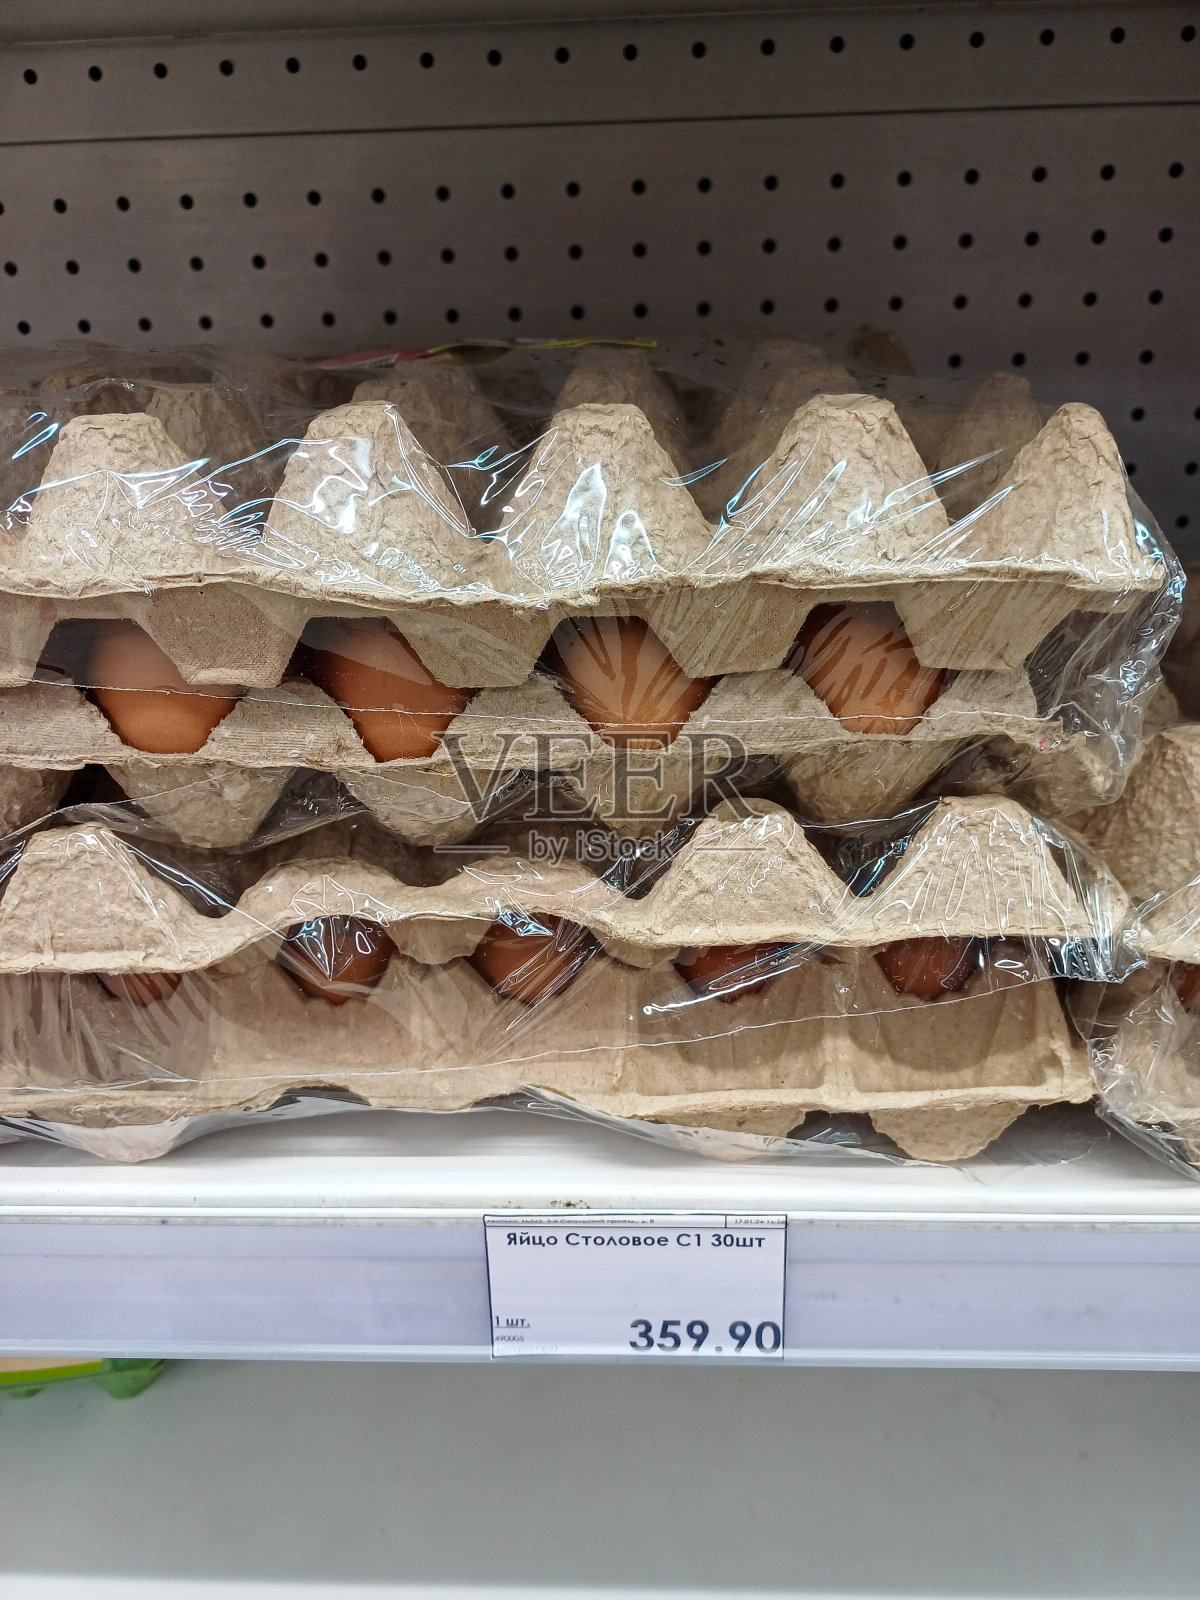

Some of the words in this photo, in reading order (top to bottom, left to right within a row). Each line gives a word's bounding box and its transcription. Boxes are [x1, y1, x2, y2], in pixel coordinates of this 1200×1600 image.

[506, 1231, 558, 1247] Яйцо
[565, 1232, 669, 1247] Столовое
[676, 1233, 702, 1247] С1
[711, 1233, 766, 1248] 30шт
[495, 1316, 500, 1327] 1
[506, 1318, 531, 1327] шт.
[629, 1319, 782, 1353] 359.90
